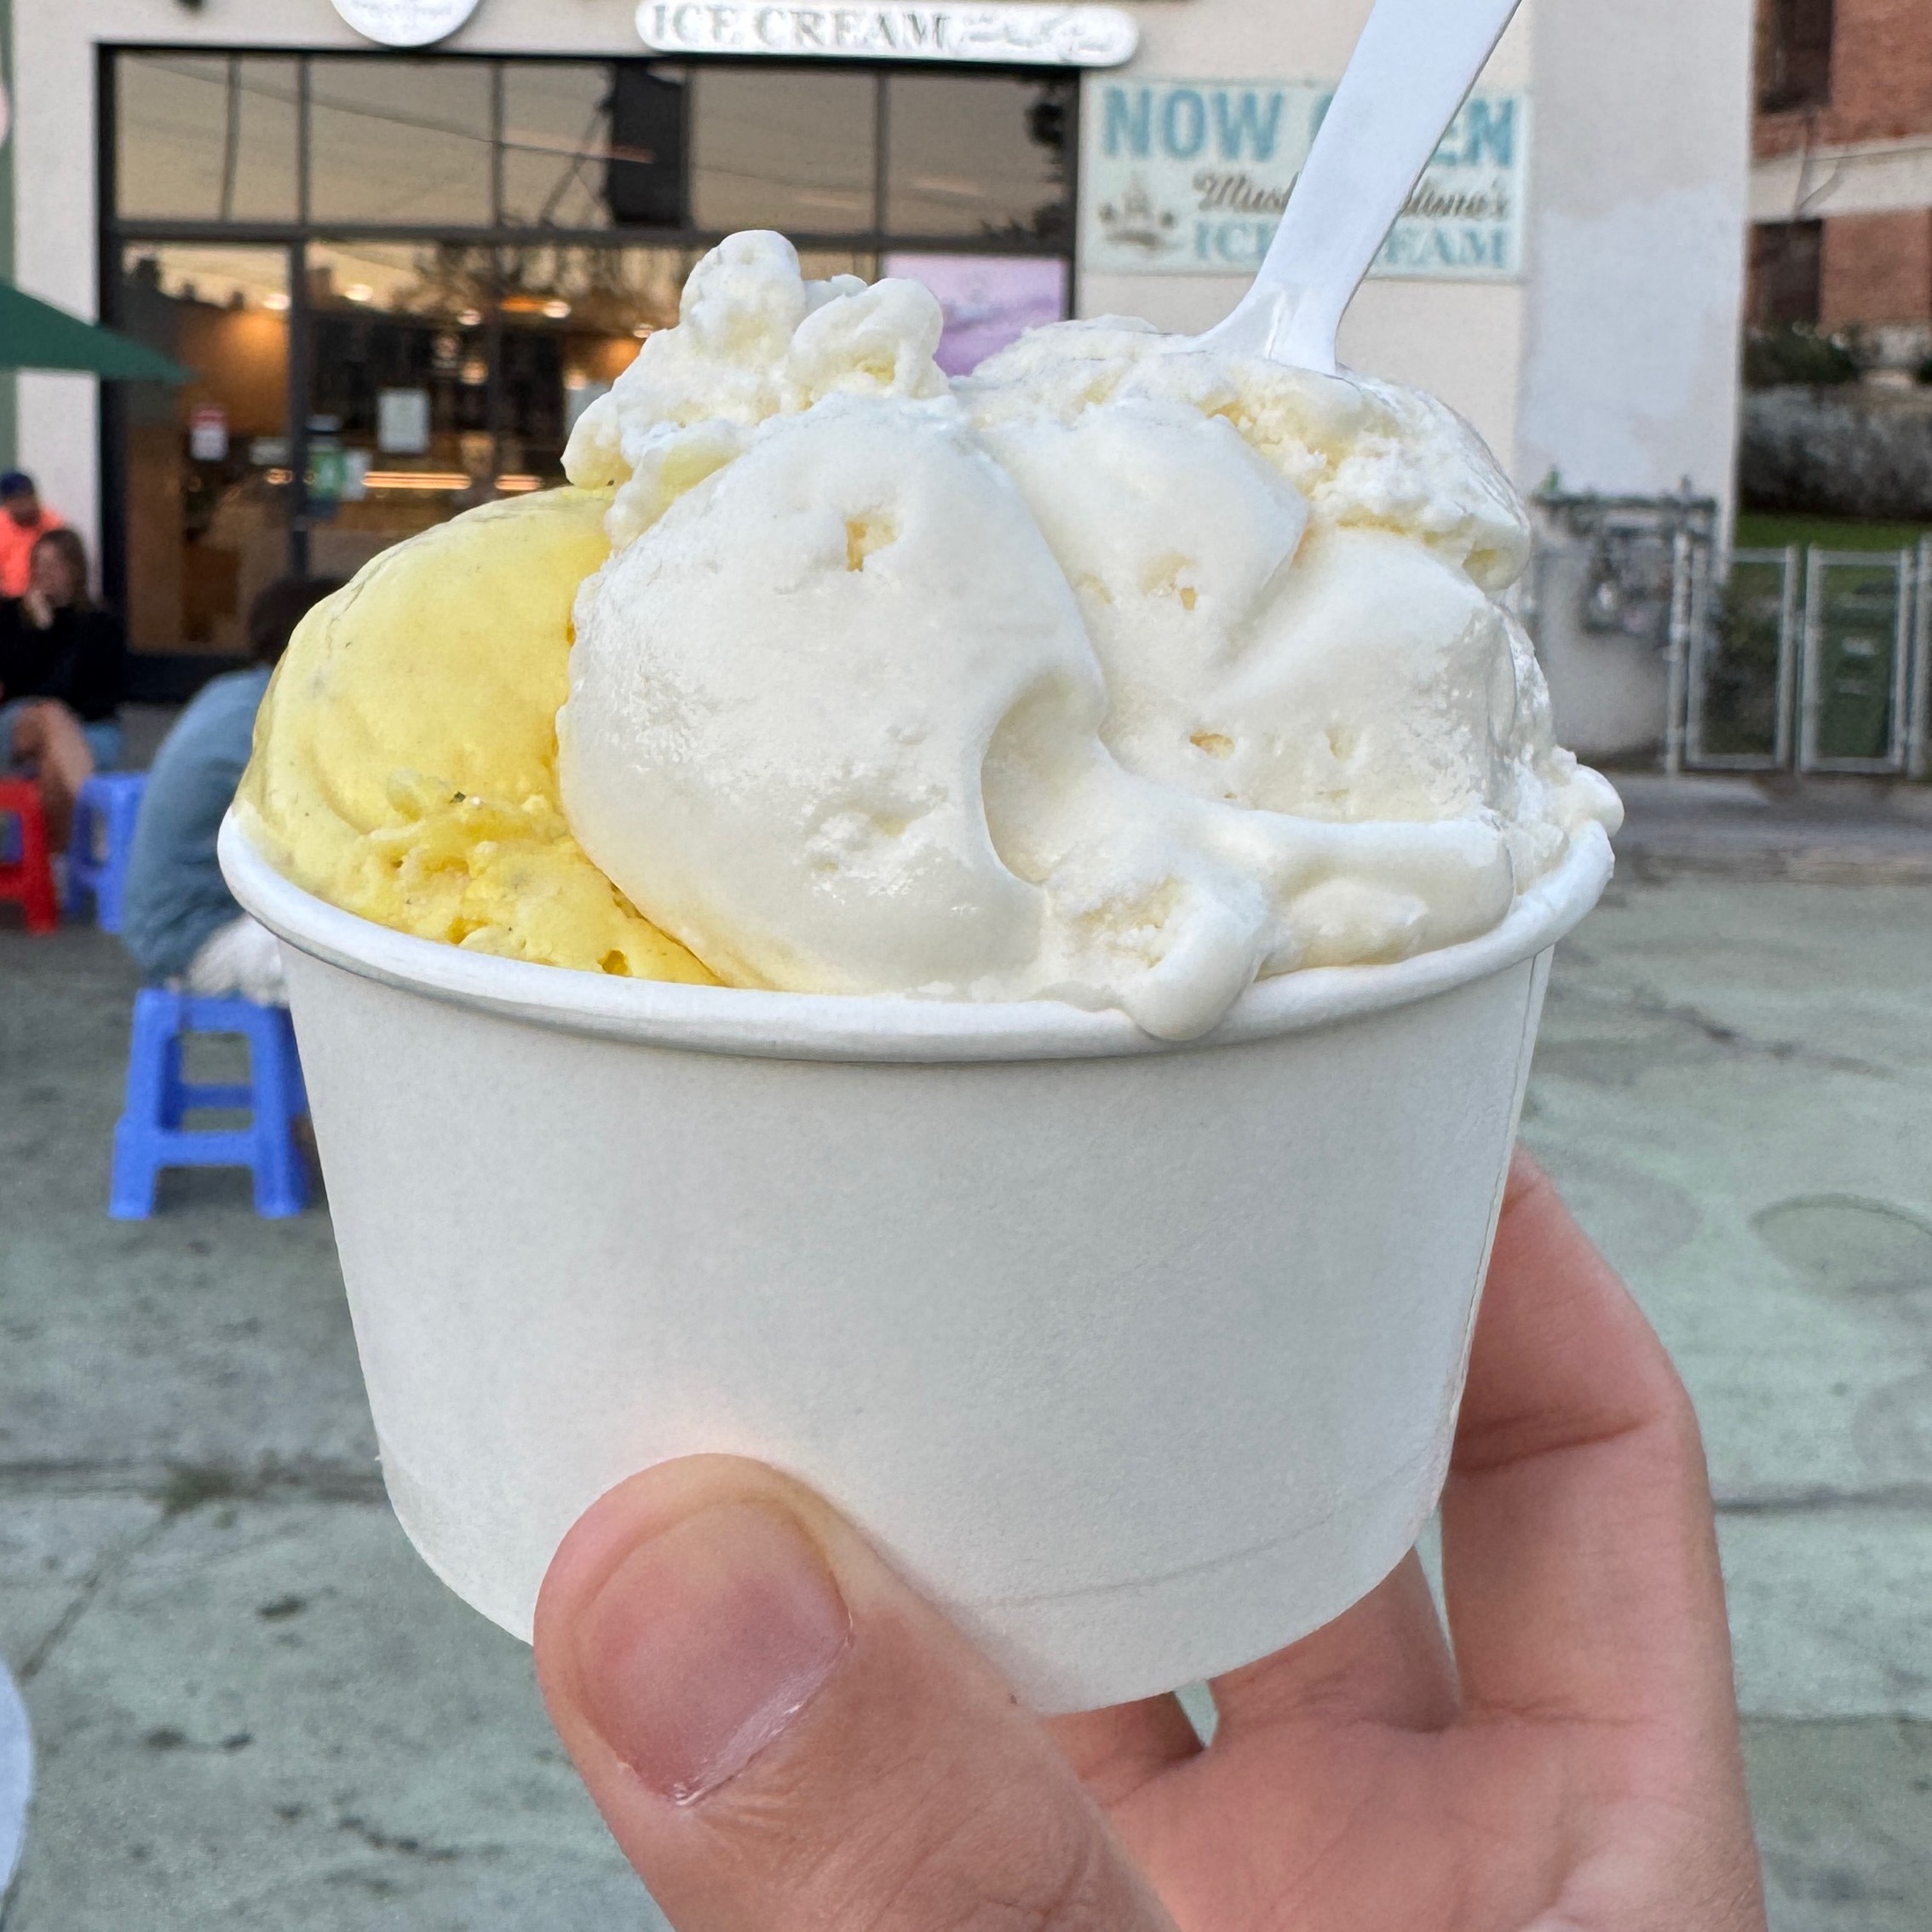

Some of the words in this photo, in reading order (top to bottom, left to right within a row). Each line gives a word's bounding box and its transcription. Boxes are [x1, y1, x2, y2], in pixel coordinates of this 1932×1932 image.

[652, 3, 745, 46] ICE
[753, 8, 951, 51] CREAM
[1103, 87, 1284, 164] NOW
[1377, 226, 1508, 269] EAM
